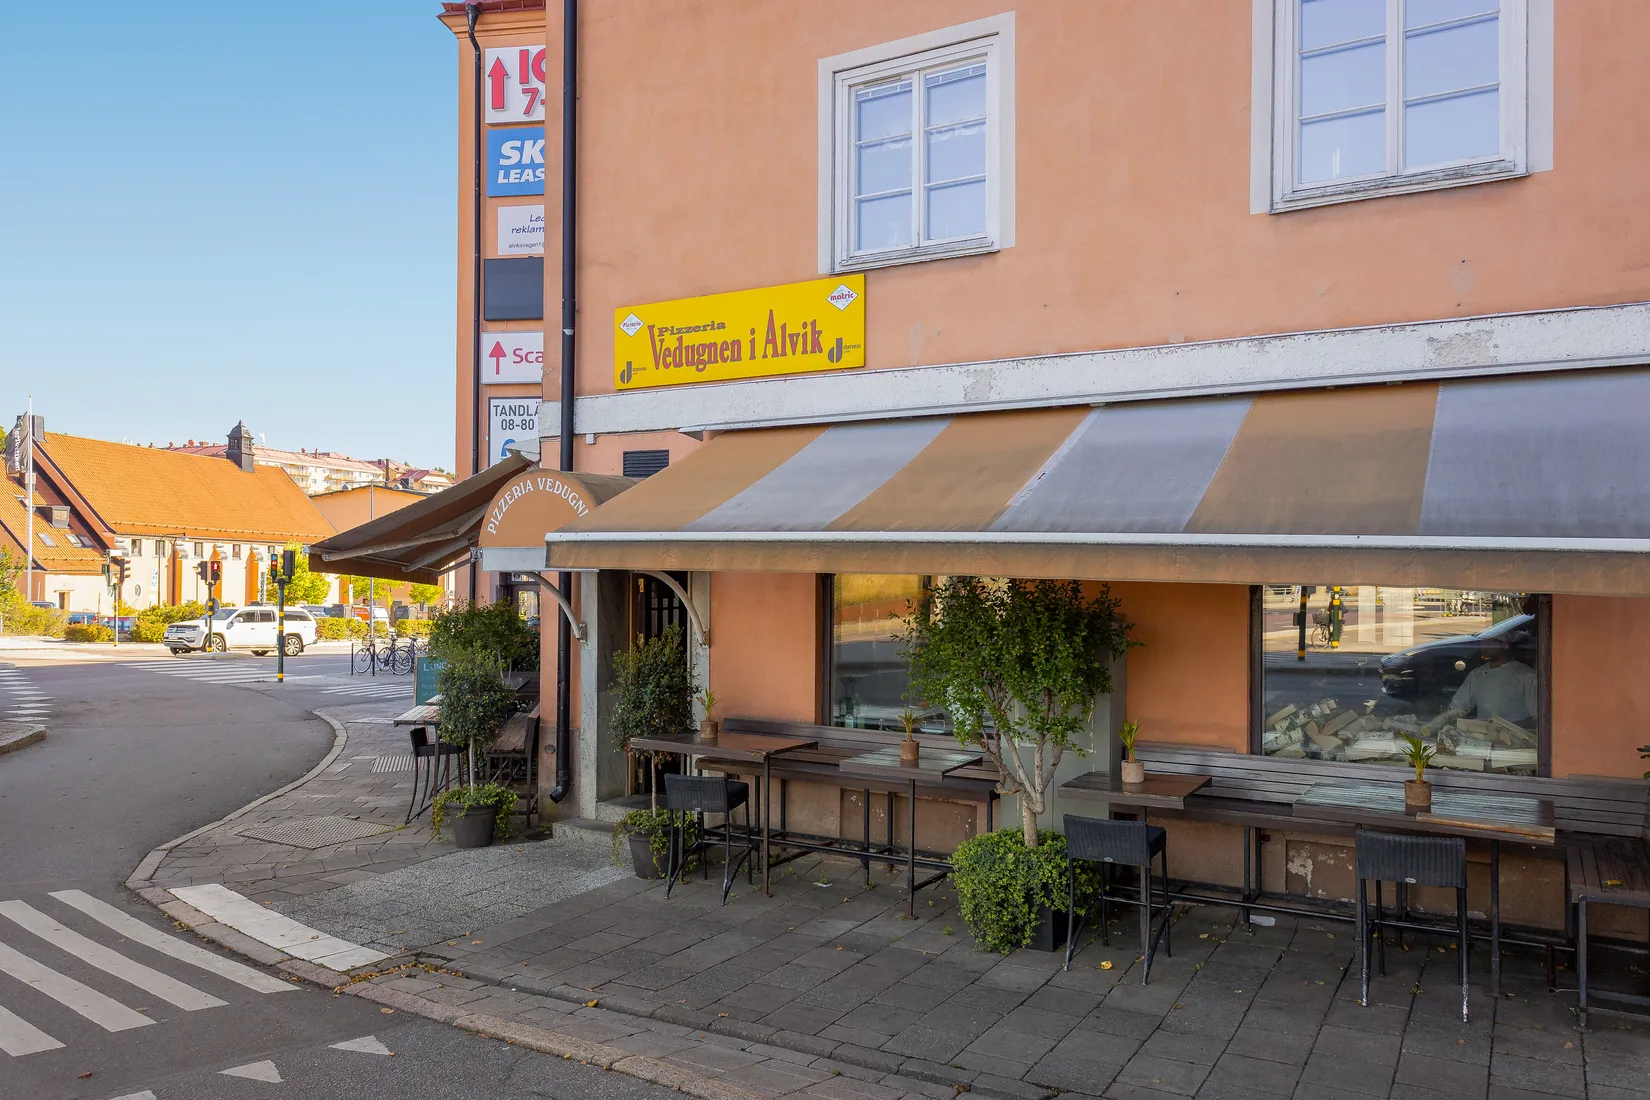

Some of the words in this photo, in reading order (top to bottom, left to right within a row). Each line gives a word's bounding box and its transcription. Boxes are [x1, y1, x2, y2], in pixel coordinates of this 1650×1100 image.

[497, 168, 545, 184] LEAS
[830, 291, 854, 301] matric
[657, 320, 727, 337] Pizzeria
[647, 324, 742, 373] Vedugnen
[749, 327, 757, 361] i
[762, 308, 824, 359] Alvik
[501, 418, 535, 431] 08-80
[486, 479, 534, 535] PIZZERIA
